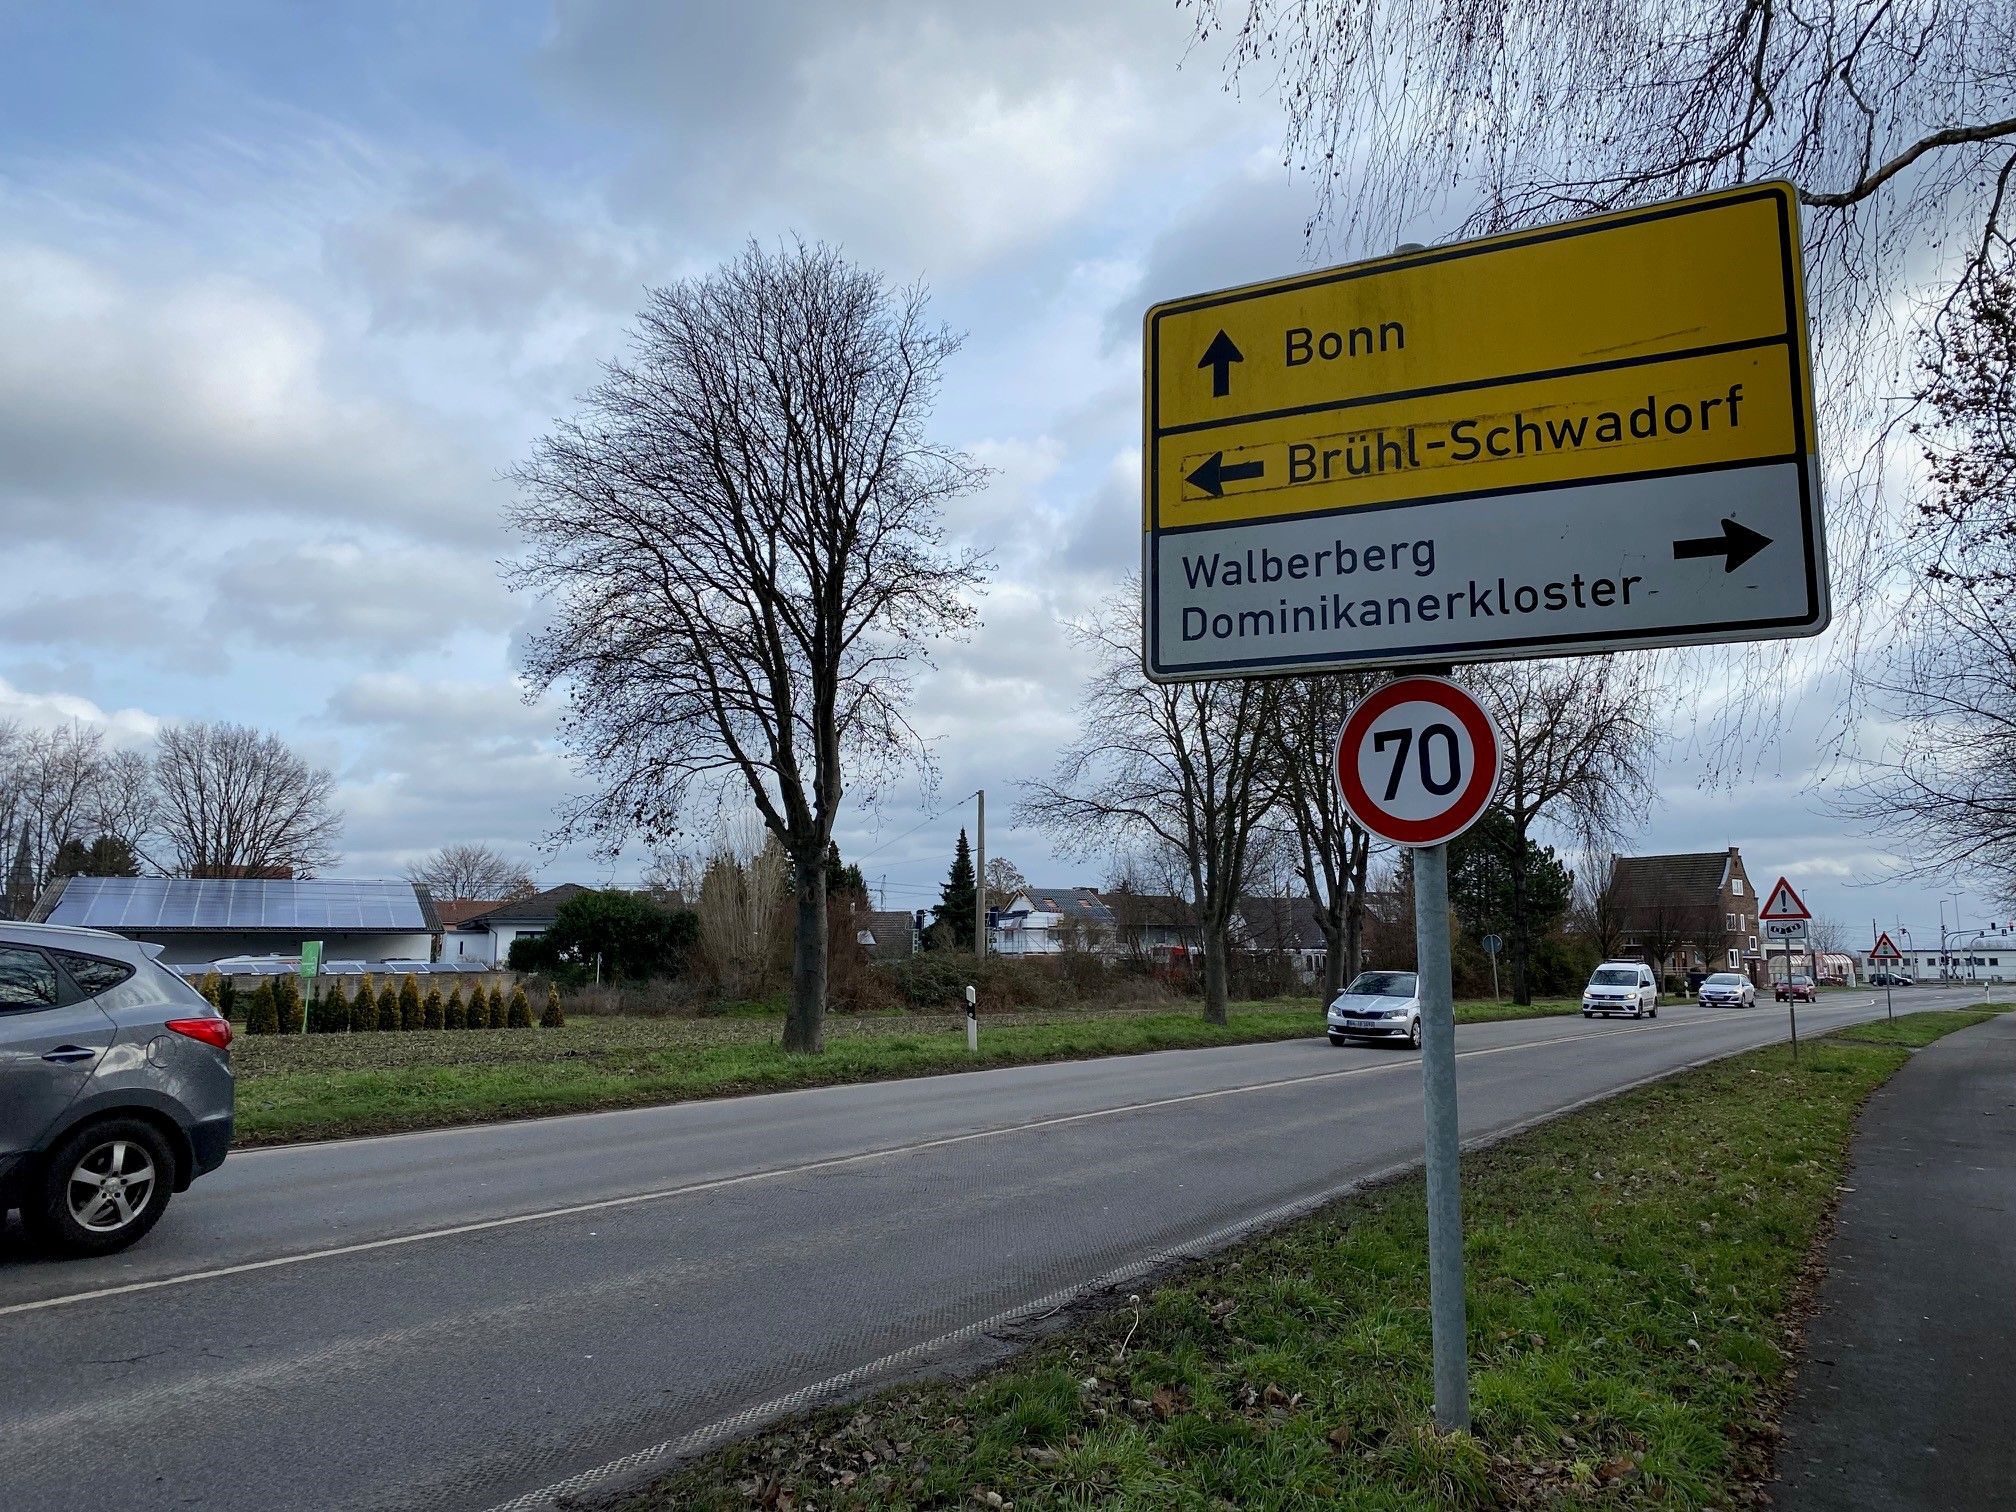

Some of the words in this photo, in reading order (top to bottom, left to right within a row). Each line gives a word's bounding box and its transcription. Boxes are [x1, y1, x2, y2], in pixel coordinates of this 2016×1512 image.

[1286, 321, 1405, 367] Bonn
[1288, 384, 1743, 484] Brühl-Schwadorf
[1182, 539, 1435, 589] Walberberg
[1182, 573, 1642, 641] Dominikanerkloster
[1373, 723, 1462, 801] 70
